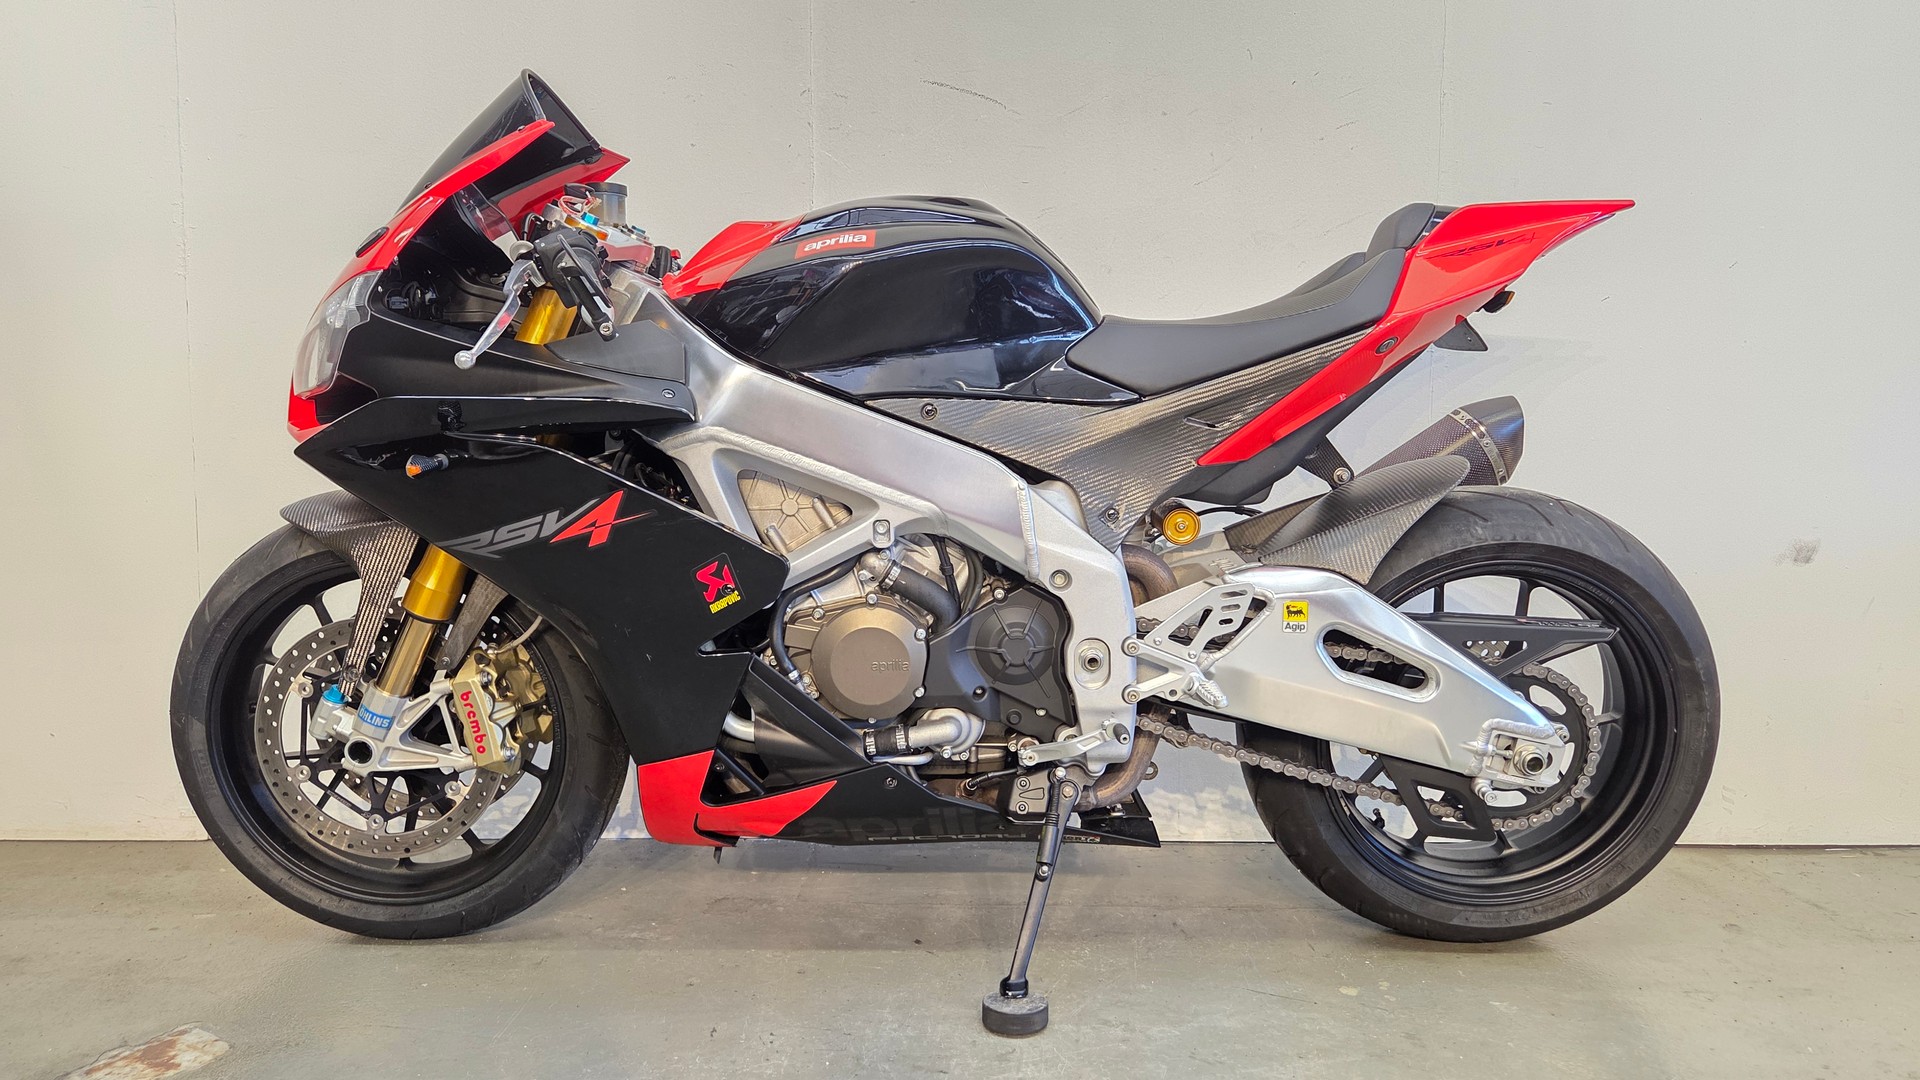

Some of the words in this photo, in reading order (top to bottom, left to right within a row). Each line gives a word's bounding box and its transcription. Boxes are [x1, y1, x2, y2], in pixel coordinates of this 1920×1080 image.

[803, 233, 867, 252] aprilia
[434, 489, 654, 559] RSV4
[1284, 622, 1306, 632] Agip
[871, 658, 910, 674] aprilia
[460, 690, 487, 754] brembo
